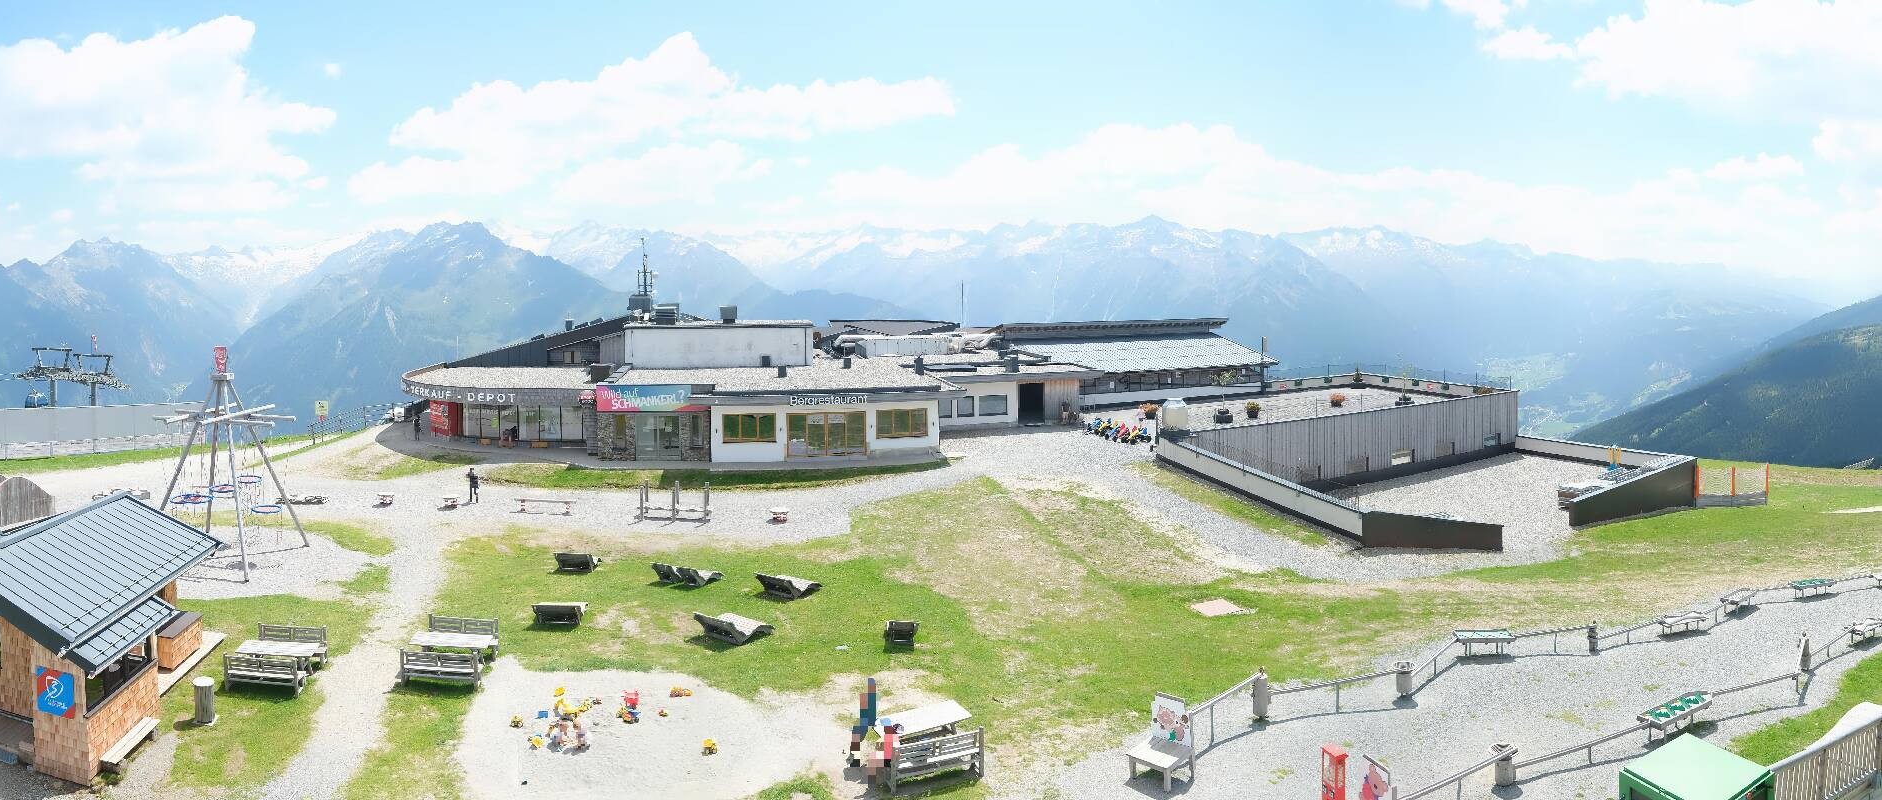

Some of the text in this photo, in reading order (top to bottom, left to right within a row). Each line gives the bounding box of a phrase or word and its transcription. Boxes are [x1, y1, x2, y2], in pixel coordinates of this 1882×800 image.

[467, 392, 516, 403] DEPOT
[601, 387, 639, 400] Wild auf
[611, 389, 685, 410] SCHMANKERL?
[789, 394, 868, 406] Bergrestaurant
